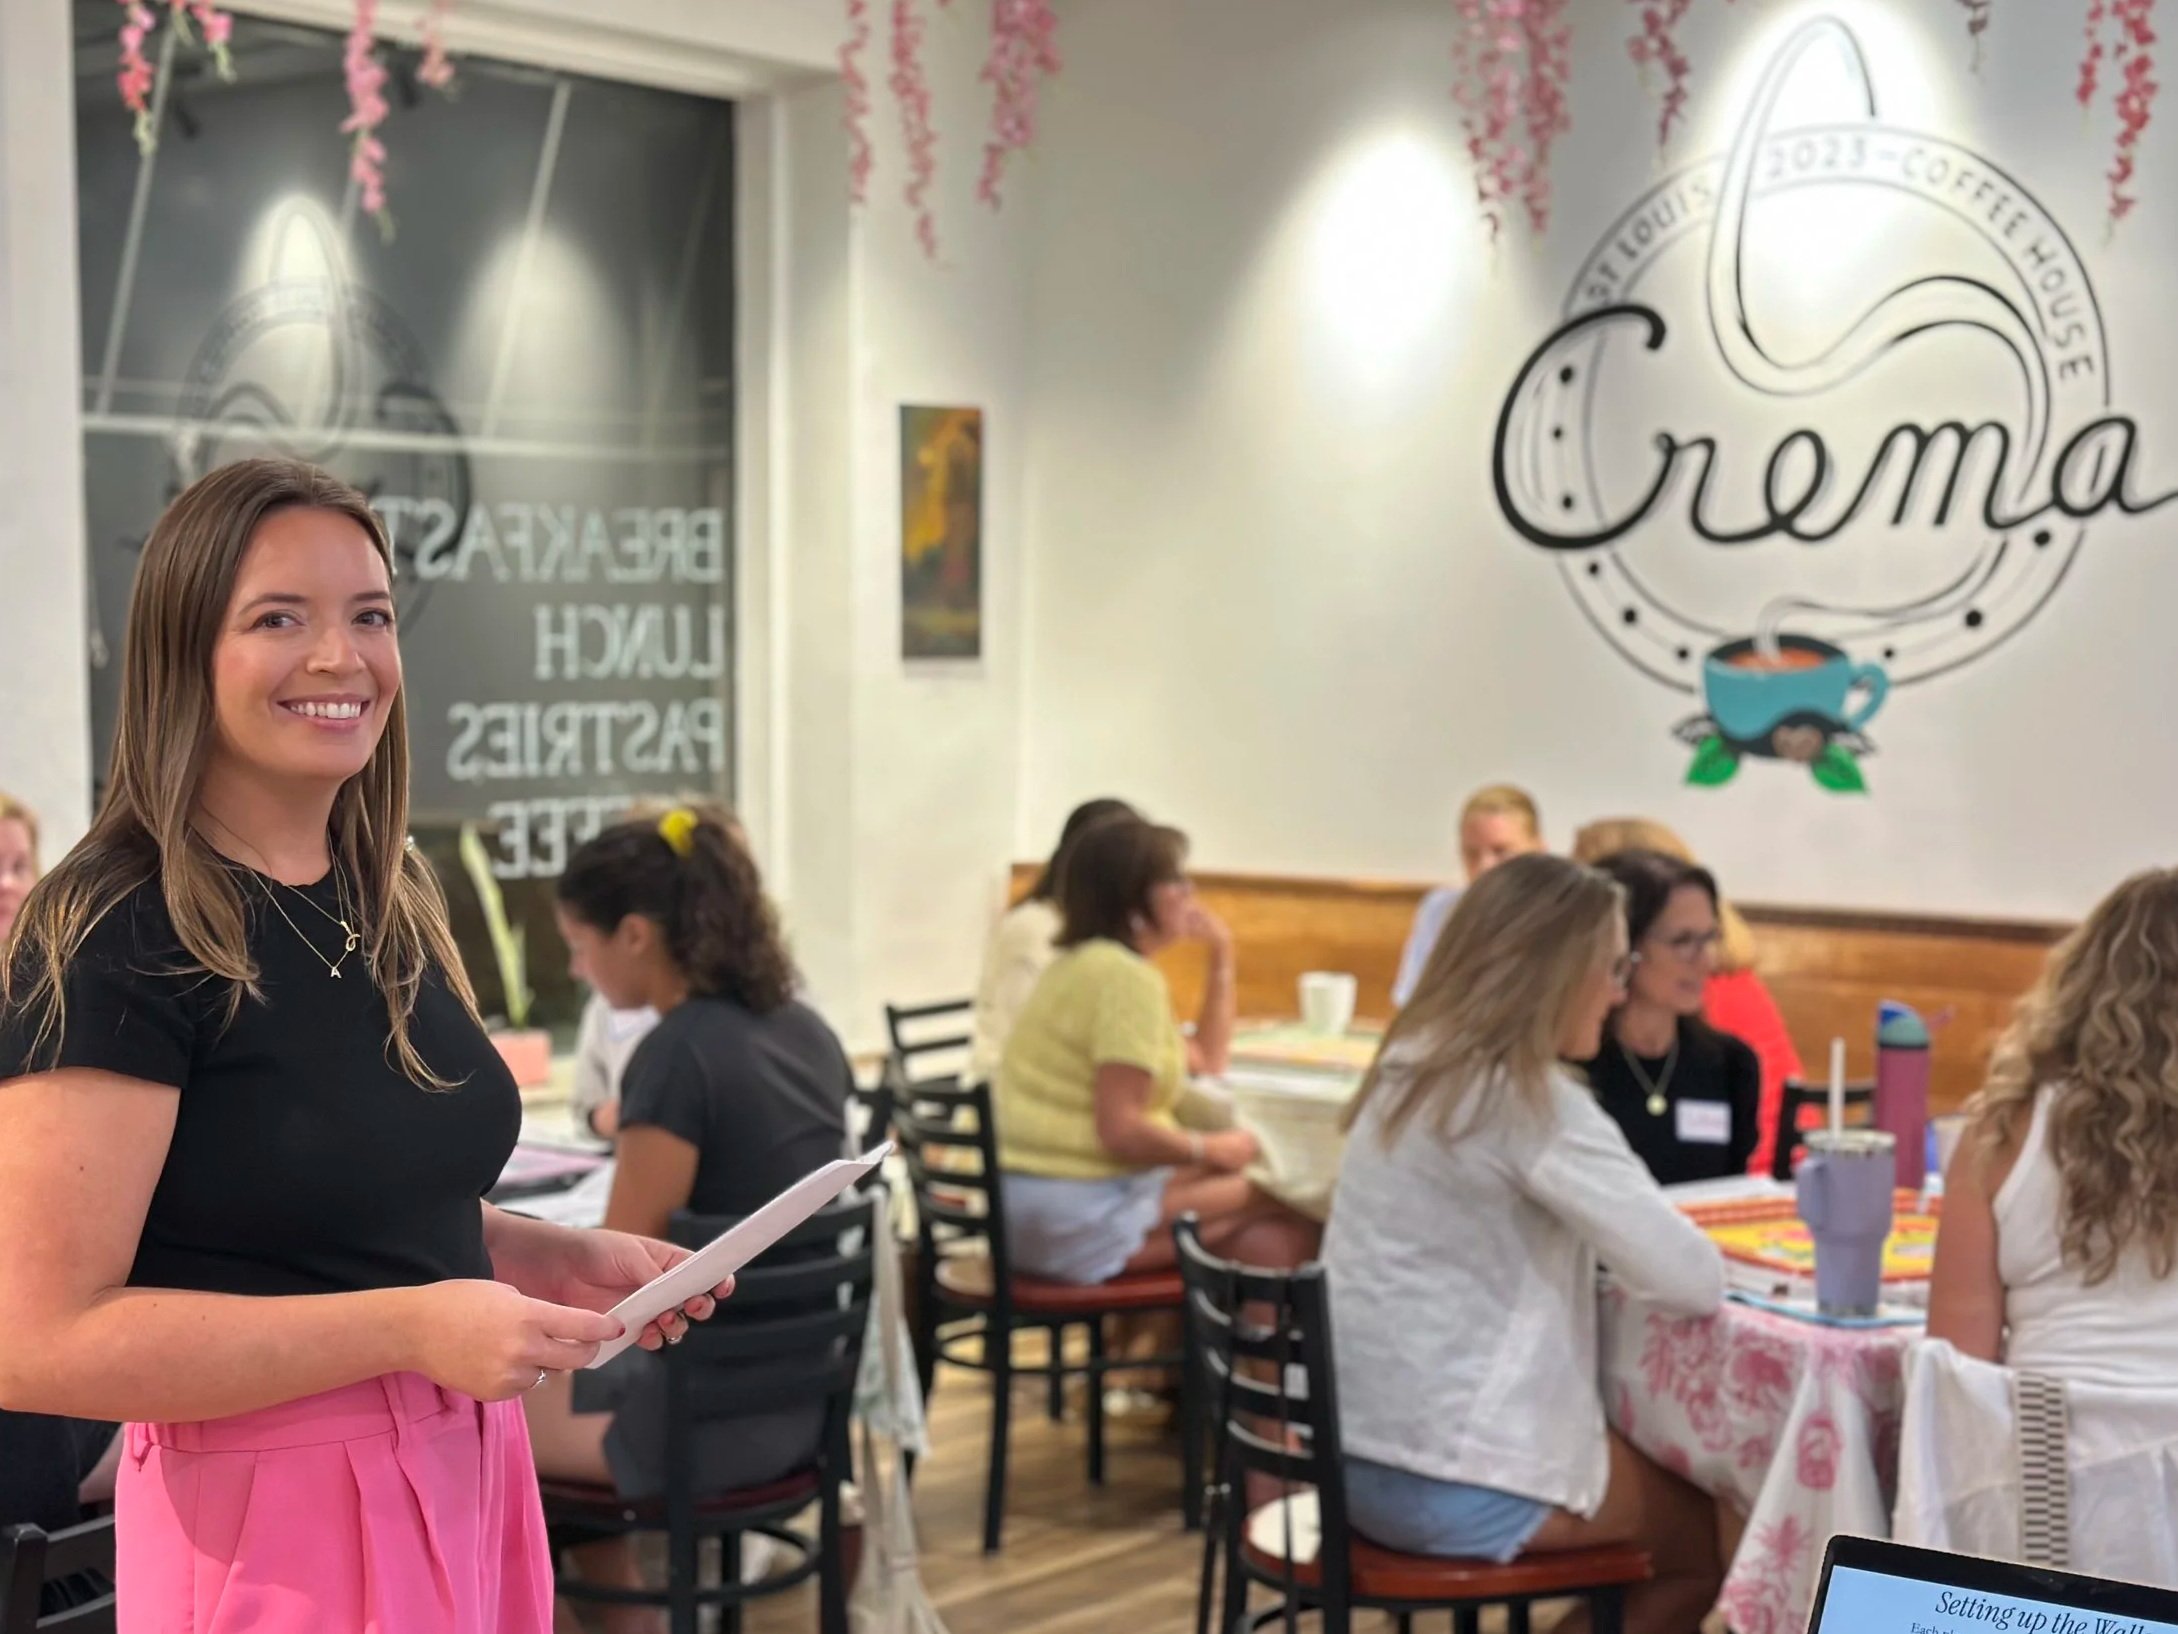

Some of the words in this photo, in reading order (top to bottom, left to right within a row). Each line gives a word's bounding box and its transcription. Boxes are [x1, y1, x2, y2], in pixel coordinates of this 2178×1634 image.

[1902, 147, 2030, 239] COFFEE
[2024, 236, 2095, 381] HOUSE
[1493, 303, 2178, 549] Crema
[1935, 1591, 2016, 1630] Setting
[2017, 1609, 2047, 1634] up
[2052, 1612, 2088, 1634] the
